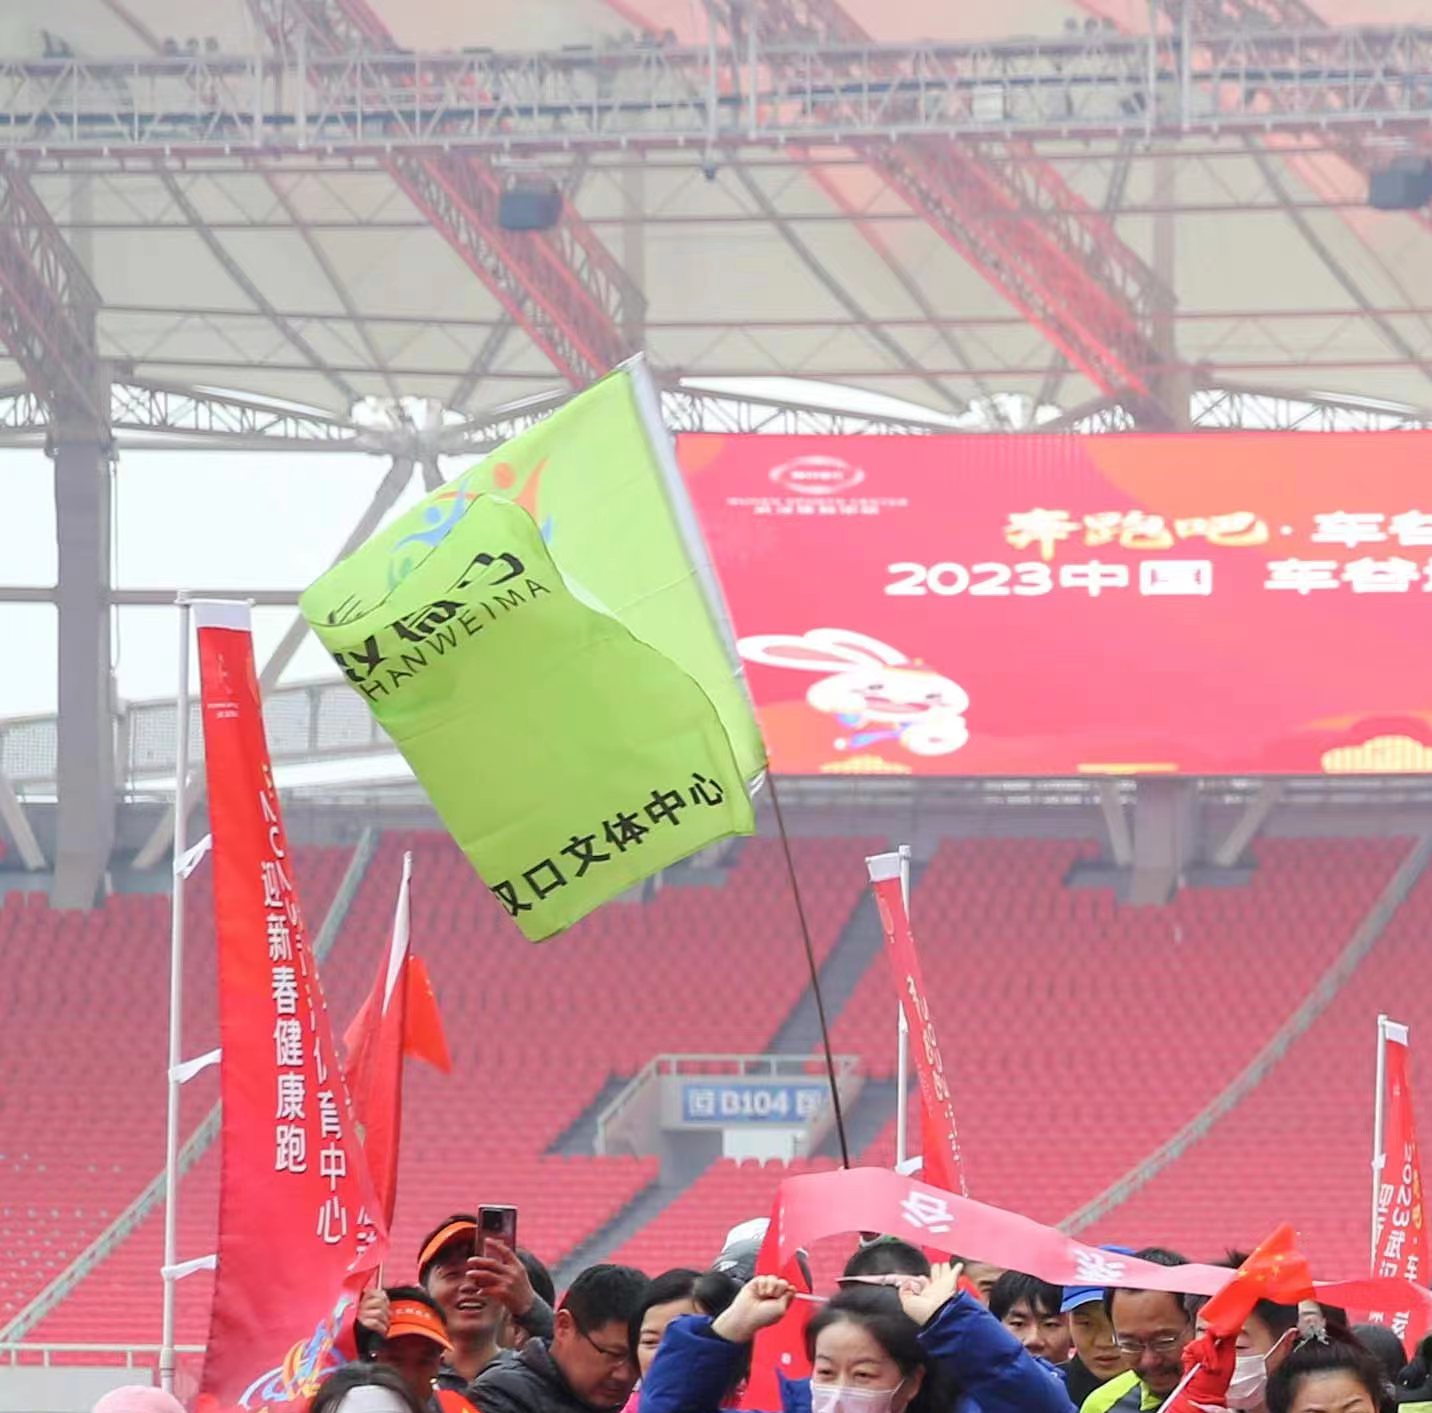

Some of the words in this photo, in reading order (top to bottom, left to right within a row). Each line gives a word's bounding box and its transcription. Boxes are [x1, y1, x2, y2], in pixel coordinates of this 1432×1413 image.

[885, 559, 1213, 597] 2023中国
[260, 860, 308, 1174] 迎新春健康跑
